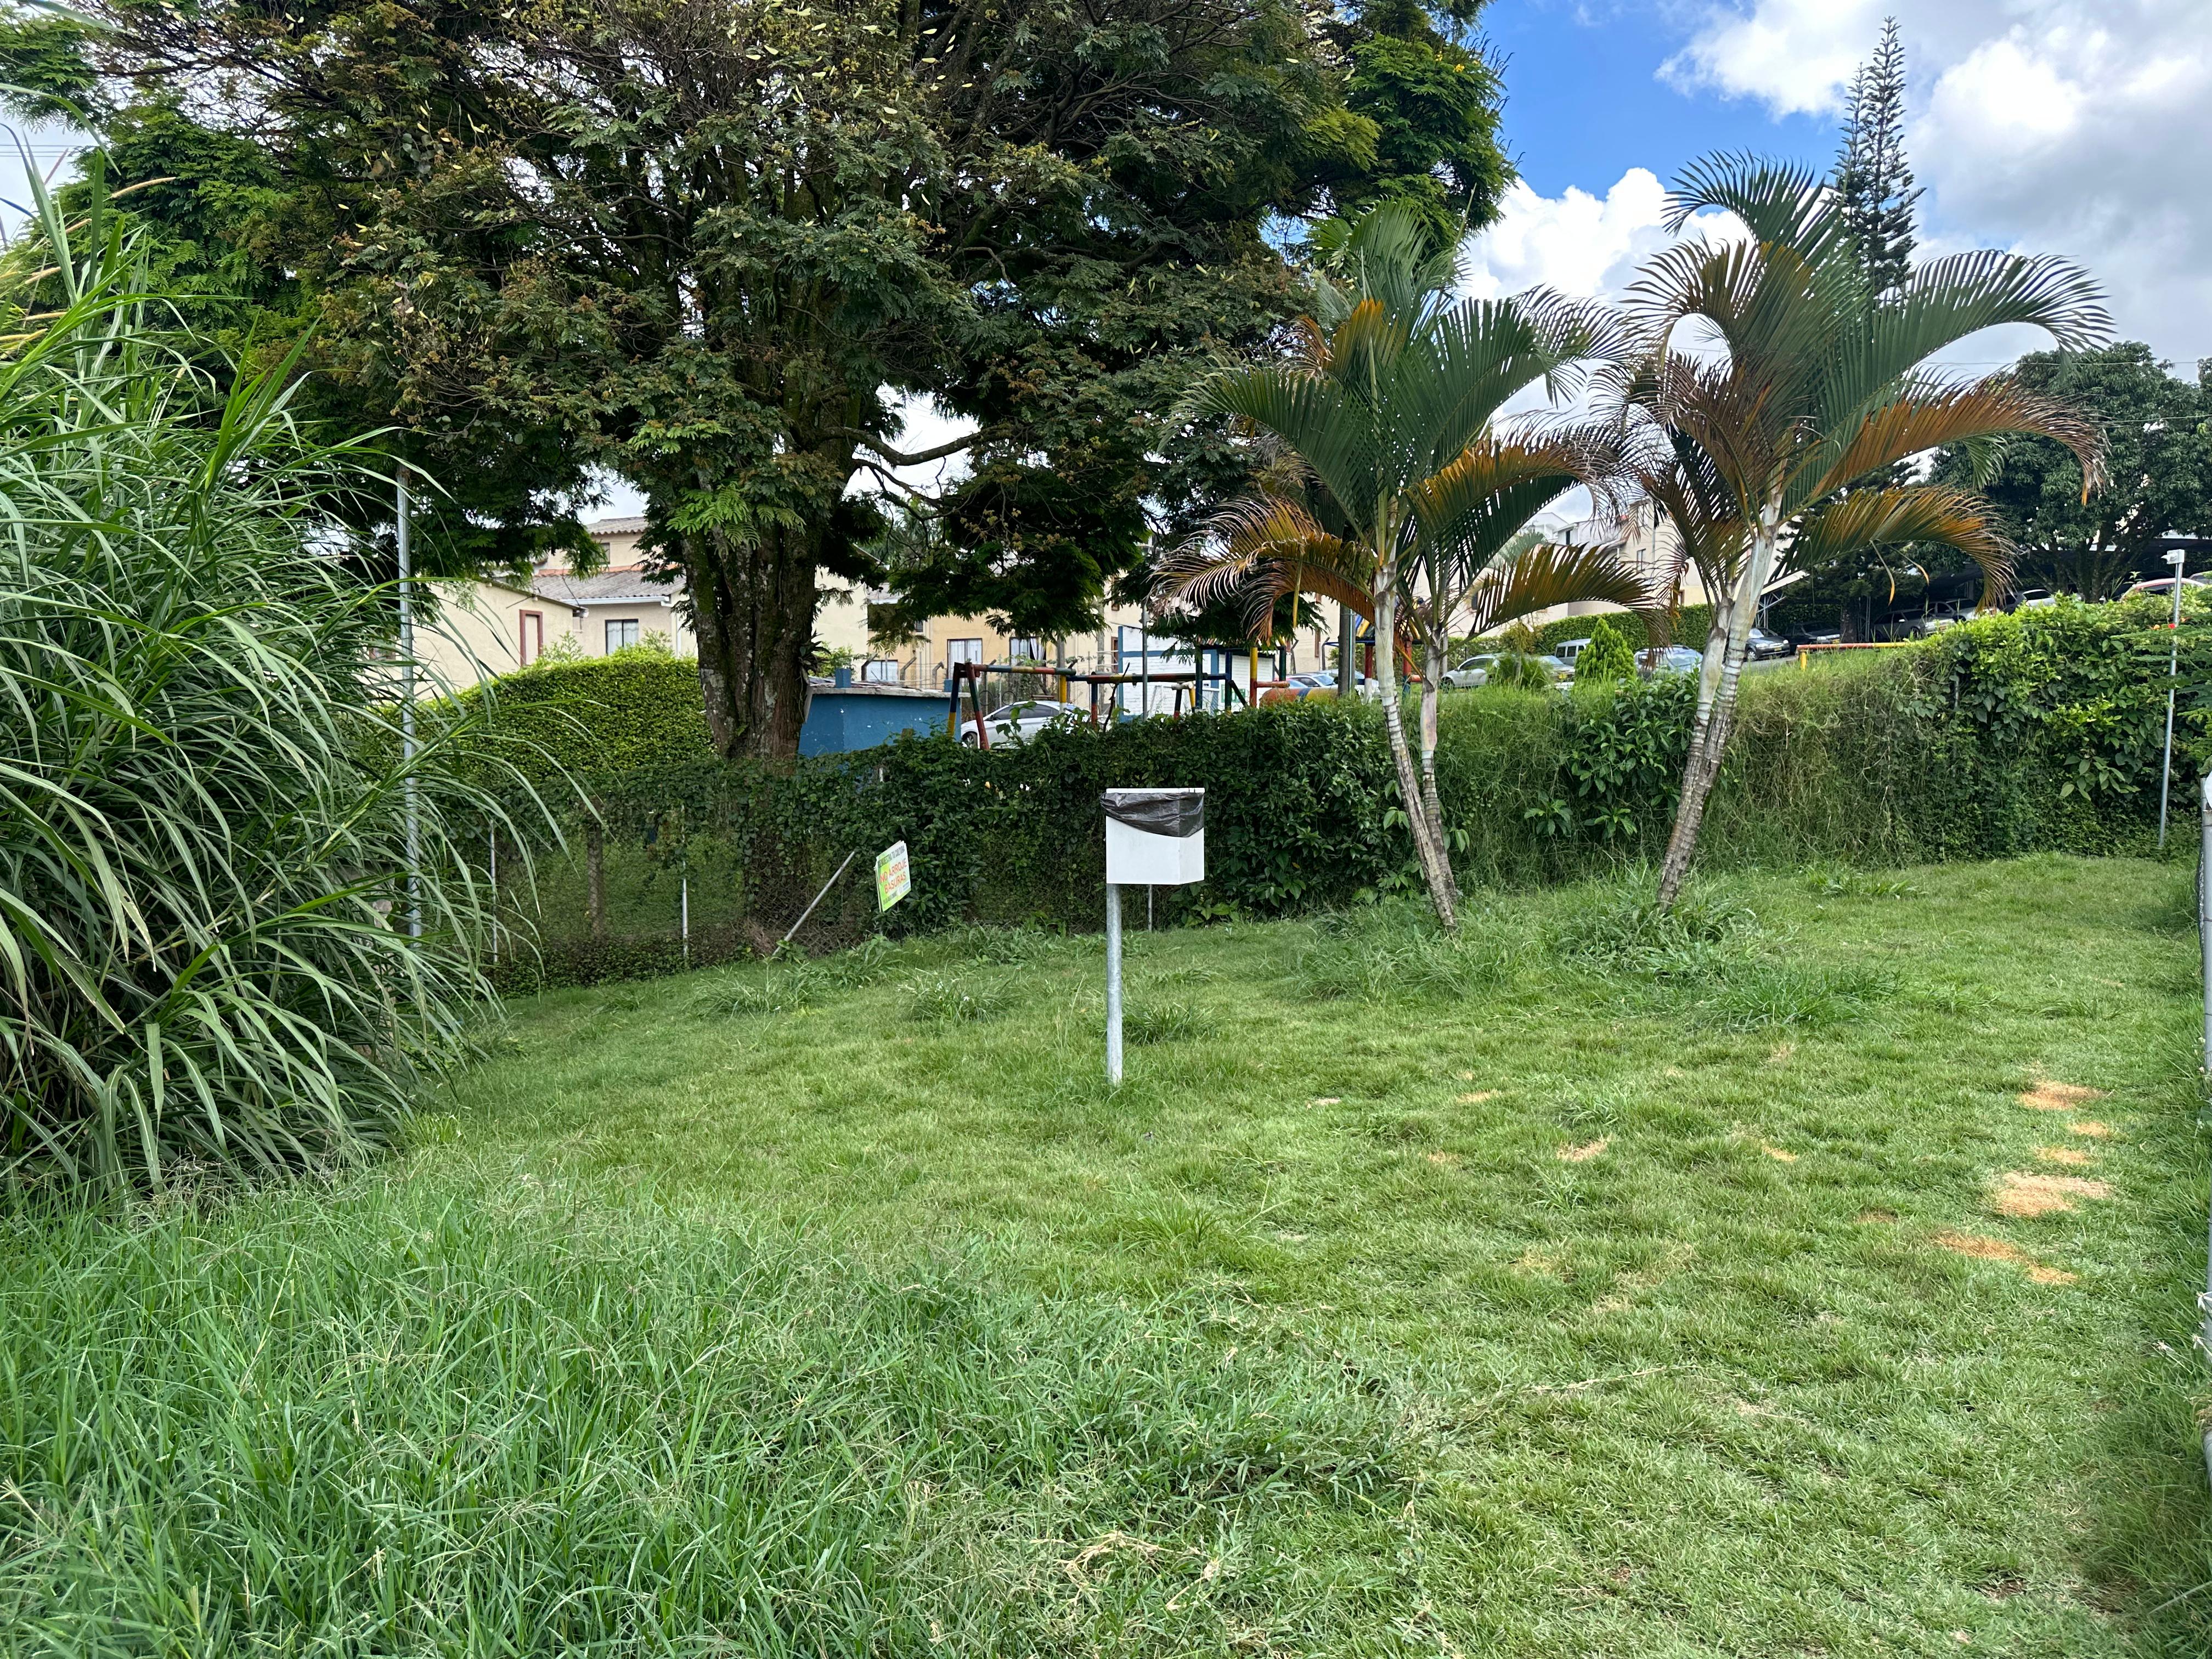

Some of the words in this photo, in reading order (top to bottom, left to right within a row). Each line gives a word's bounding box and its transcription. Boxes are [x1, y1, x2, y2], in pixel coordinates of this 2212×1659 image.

[879, 871, 888, 883] NO
[889, 858, 907, 877] ARROJE
[884, 871, 906, 894] BASURAS
